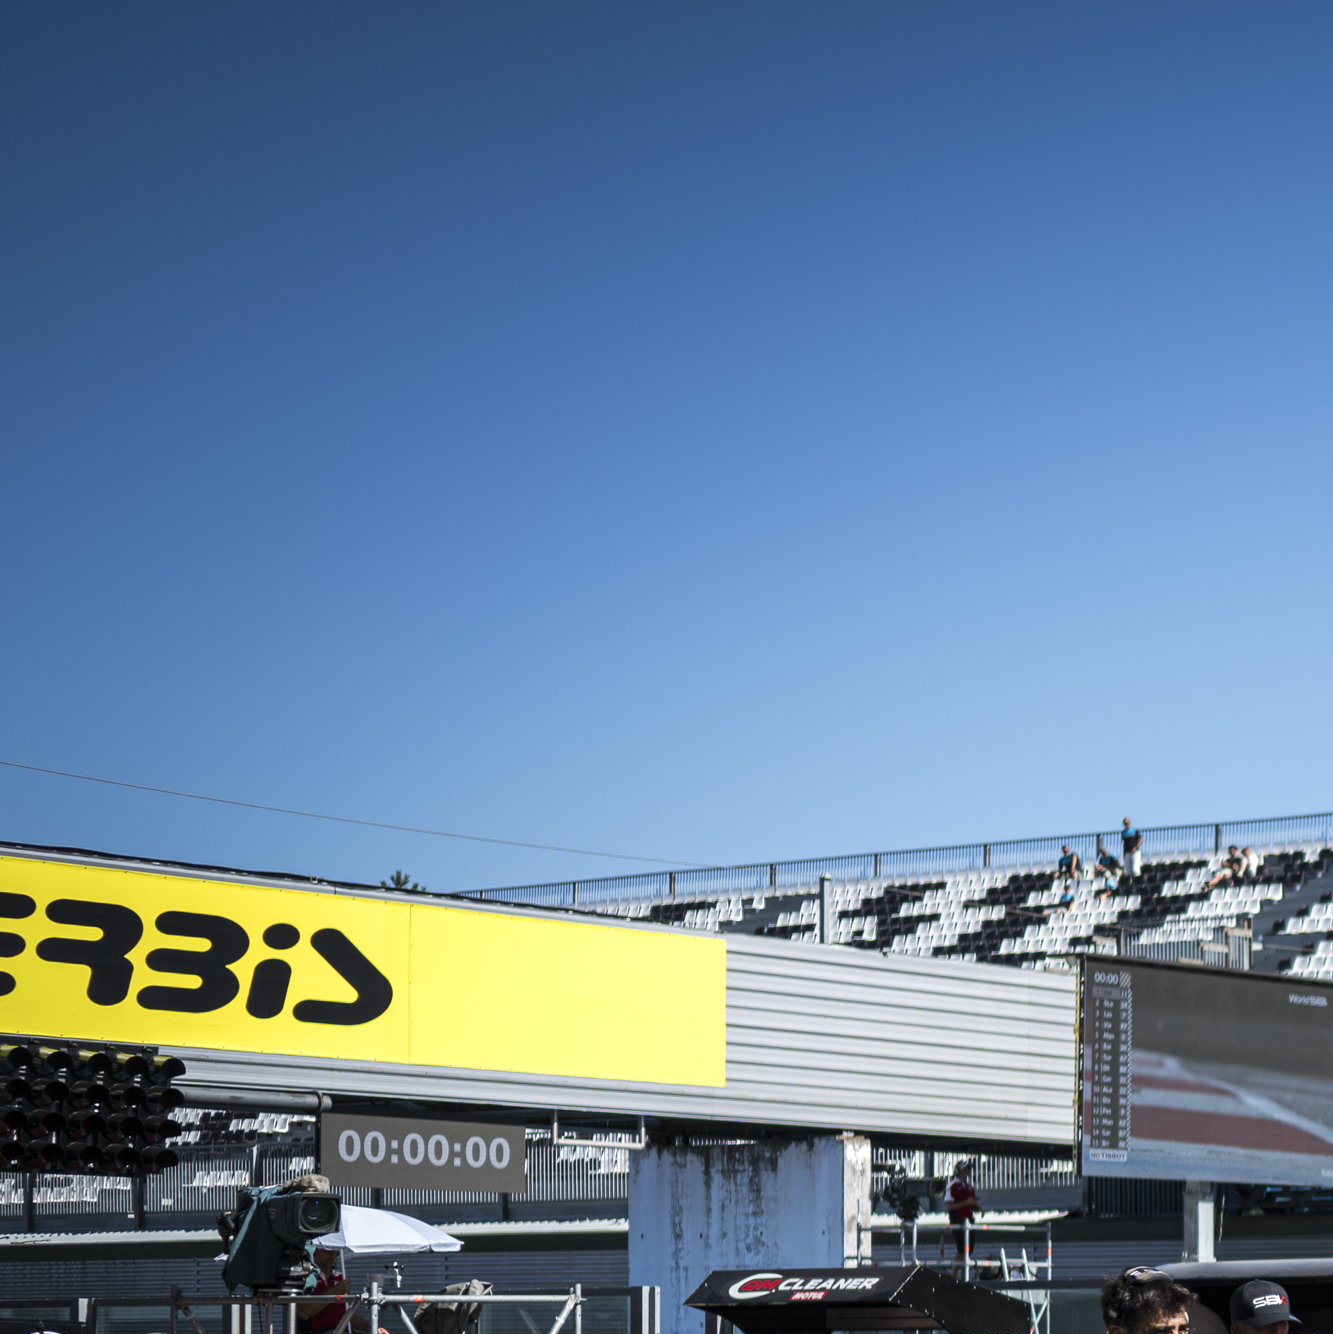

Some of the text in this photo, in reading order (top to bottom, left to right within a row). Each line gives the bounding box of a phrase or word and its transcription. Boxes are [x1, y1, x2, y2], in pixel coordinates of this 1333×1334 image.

[1094, 972, 1119, 985] 00:00
[338, 1128, 511, 1169] 00:00:00
[778, 1277, 880, 1291] CLEANER
[792, 1291, 825, 1300] MOTUL
[1253, 1294, 1287, 1308] SBK
